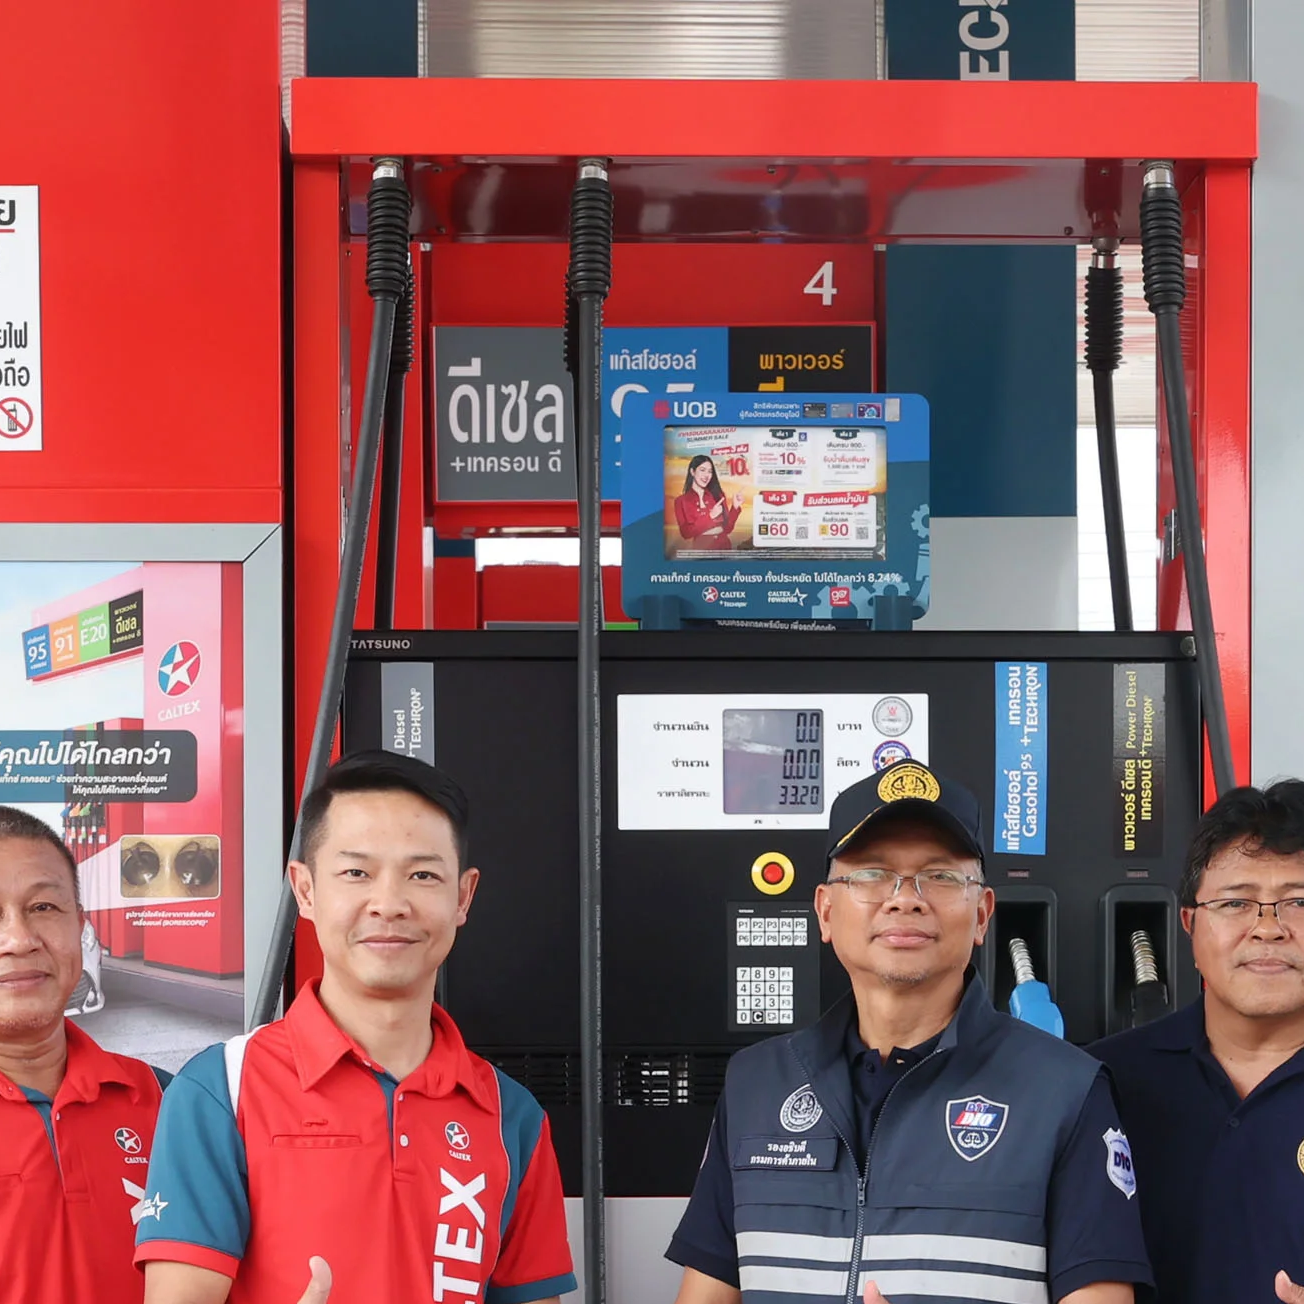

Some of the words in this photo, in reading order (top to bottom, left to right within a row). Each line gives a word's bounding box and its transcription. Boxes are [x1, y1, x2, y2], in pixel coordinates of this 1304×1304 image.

[959, 0, 1009, 81] EC
[804, 261, 837, 305] 4
[759, 349, 845, 371] พาวเวอร์
[447, 357, 565, 444] ดีเซล
[673, 401, 717, 418] UOB
[450, 452, 539, 472] +เทครอน
[548, 449, 562, 472] ดี
[770, 524, 789, 536] 60
[830, 524, 849, 536] 90
[55, 634, 73, 653] 91
[81, 623, 107, 646] E20
[351, 639, 411, 649] TATSUNO
[28, 642, 47, 664] 95
[1009, 666, 1021, 725] เทครอน
[1126, 671, 1136, 708] Diesel
[158, 700, 201, 721] CALTEX
[393, 709, 406, 749] Diesel
[796, 712, 820, 743] 0.0
[837, 722, 862, 731] บาท
[1126, 713, 1136, 749] Power
[783, 749, 820, 779] 0.00
[1121, 759, 1136, 791] ดีเซล
[1022, 770, 1038, 837] Gasohol
[1121, 793, 1136, 851] พาวเวอร์
[740, 970, 747, 979] 7
[754, 970, 761, 979] 8
[768, 970, 775, 979] 9
[740, 984, 747, 993] 4
[754, 984, 761, 993] 5
[768, 984, 775, 993] 6
[740, 998, 747, 1007] 1
[754, 998, 761, 1007] 2
[768, 998, 775, 1007] 3
[740, 1013, 747, 1022] 0
[753, 1011, 763, 1022] C
[448, 1149, 472, 1162] CALTEX
